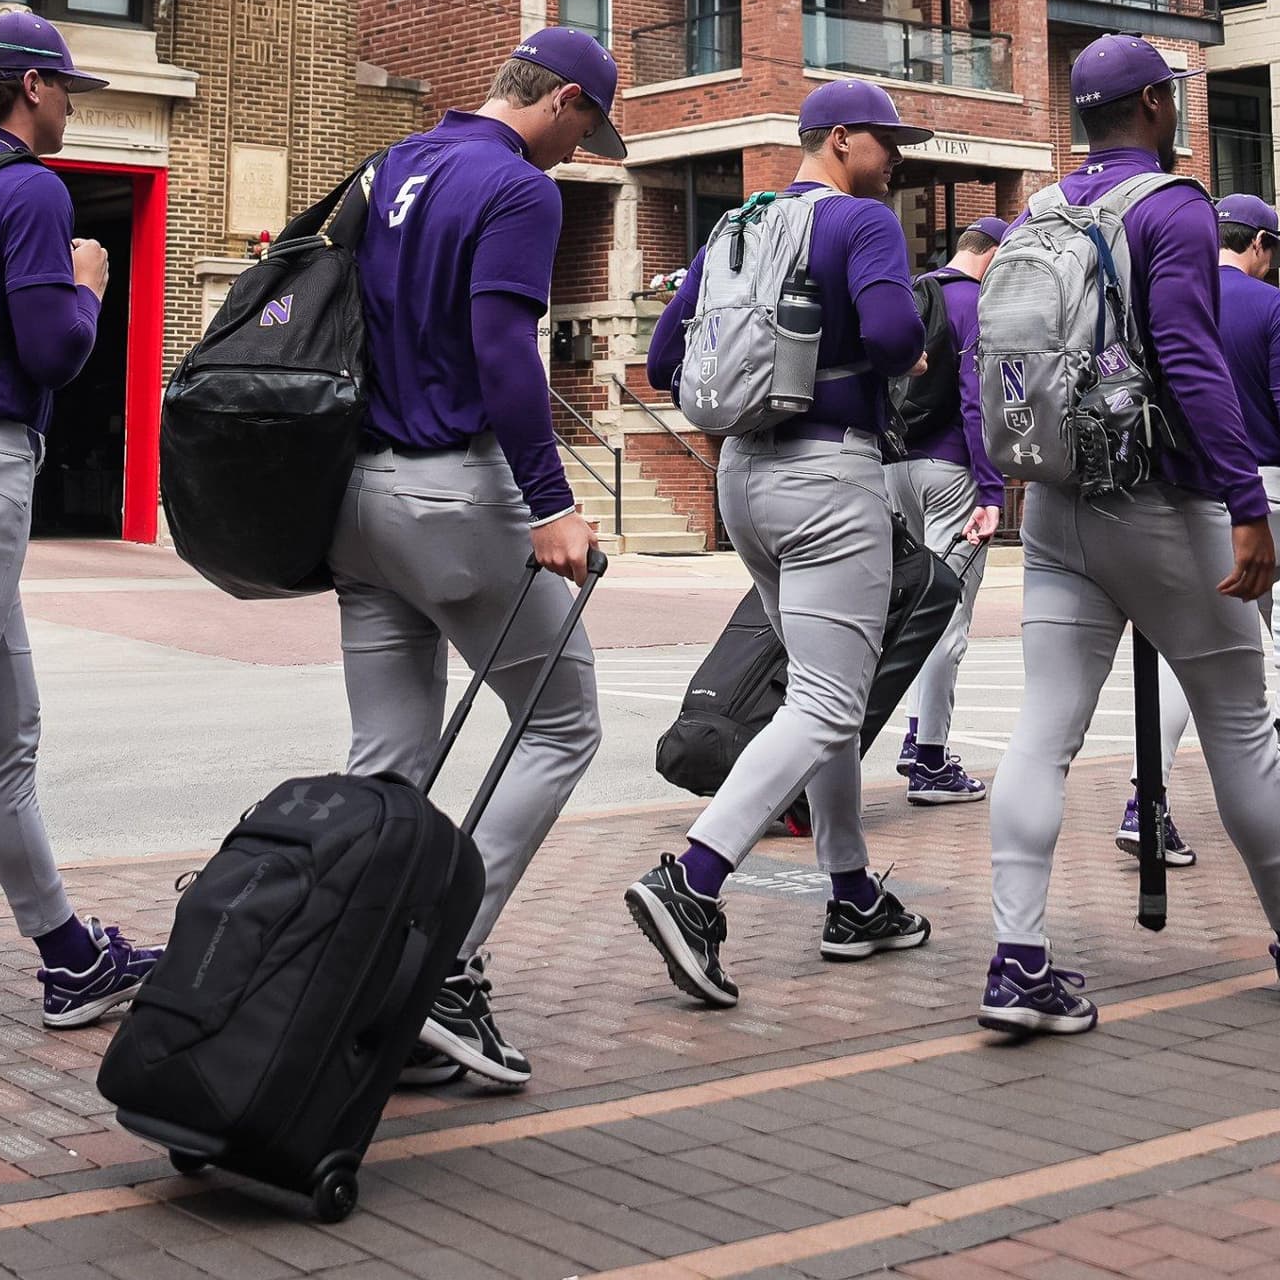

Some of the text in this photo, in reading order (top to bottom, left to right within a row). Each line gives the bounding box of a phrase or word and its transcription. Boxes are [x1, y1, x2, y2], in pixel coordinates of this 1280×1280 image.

[935, 140, 970, 155] VIEW
[388, 174, 429, 228] 5
[260, 294, 294, 326] N
[702, 315, 721, 354] N
[701, 361, 711, 375] 21
[999, 359, 1026, 404] N
[1010, 412, 1028, 427] 24
[192, 862, 269, 989] UNDER ARMOUR
